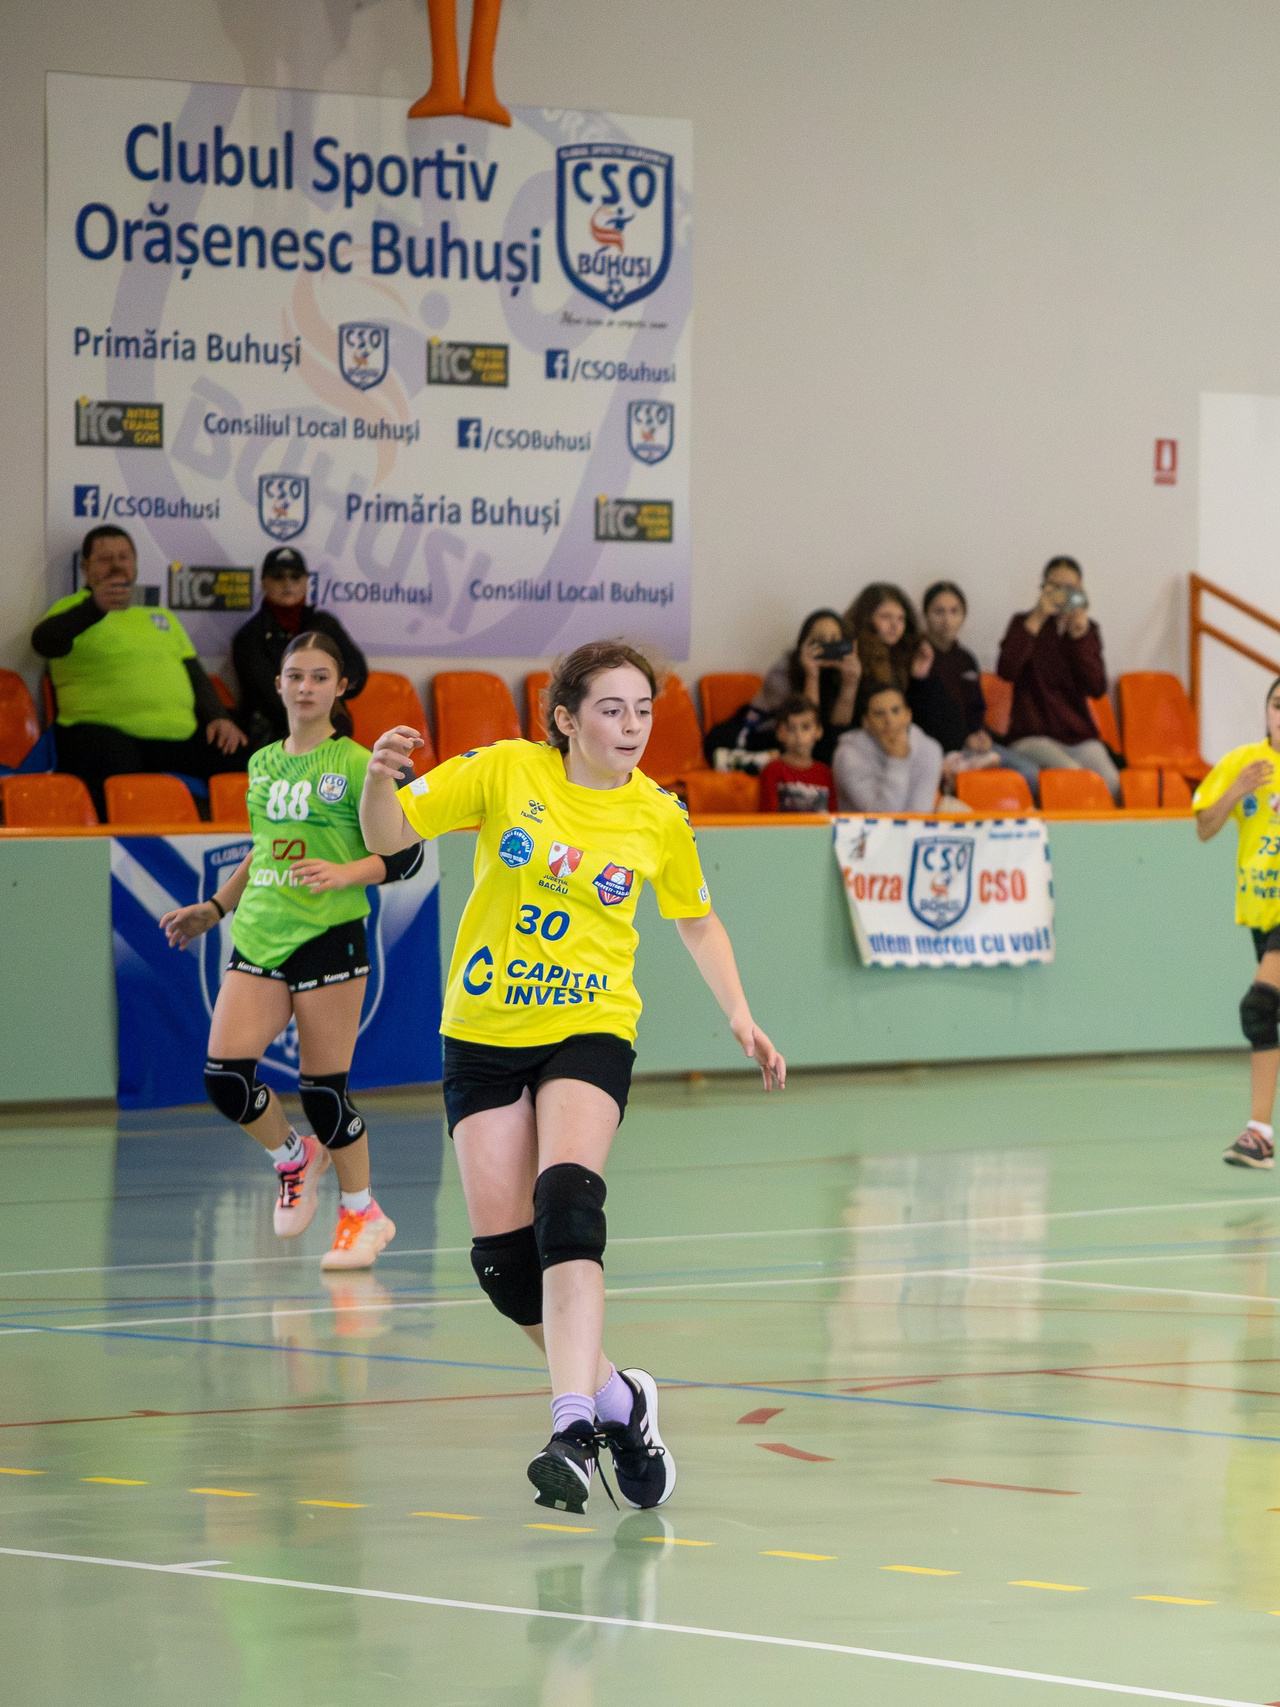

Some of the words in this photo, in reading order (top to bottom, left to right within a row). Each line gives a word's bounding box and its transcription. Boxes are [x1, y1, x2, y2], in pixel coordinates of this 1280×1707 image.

[125, 121, 294, 190] Clubul
[312, 136, 498, 207] Sportiv
[573, 162, 657, 208] CSO
[74, 201, 353, 280] Orășenesc
[371, 220, 541, 295] Buhuși
[73, 327, 196, 362] Primăria
[206, 333, 301, 373] Buhuși
[345, 329, 382, 349] CSO
[204, 411, 293, 438] Consiliul
[297, 415, 347, 438] Local
[354, 417, 421, 446] Buhuși
[634, 405, 668, 425] CSO
[265, 479, 302, 500] CSO
[346, 492, 462, 525] Primăria
[471, 496, 560, 535] Buhuși
[469, 577, 551, 601] Consiliul
[557, 579, 605, 603] Local
[610, 581, 673, 608] Buhuși
[266, 779, 312, 820] 88
[922, 845, 967, 872] CSO
[978, 868, 1028, 904] CSO
[515, 904, 570, 941] 30
[915, 934, 976, 955] mereu
[981, 934, 1005, 954] cu
[1009, 927, 1050, 952] voi!
[506, 959, 611, 991] CAPITAL
[504, 985, 595, 1006] INVEST
